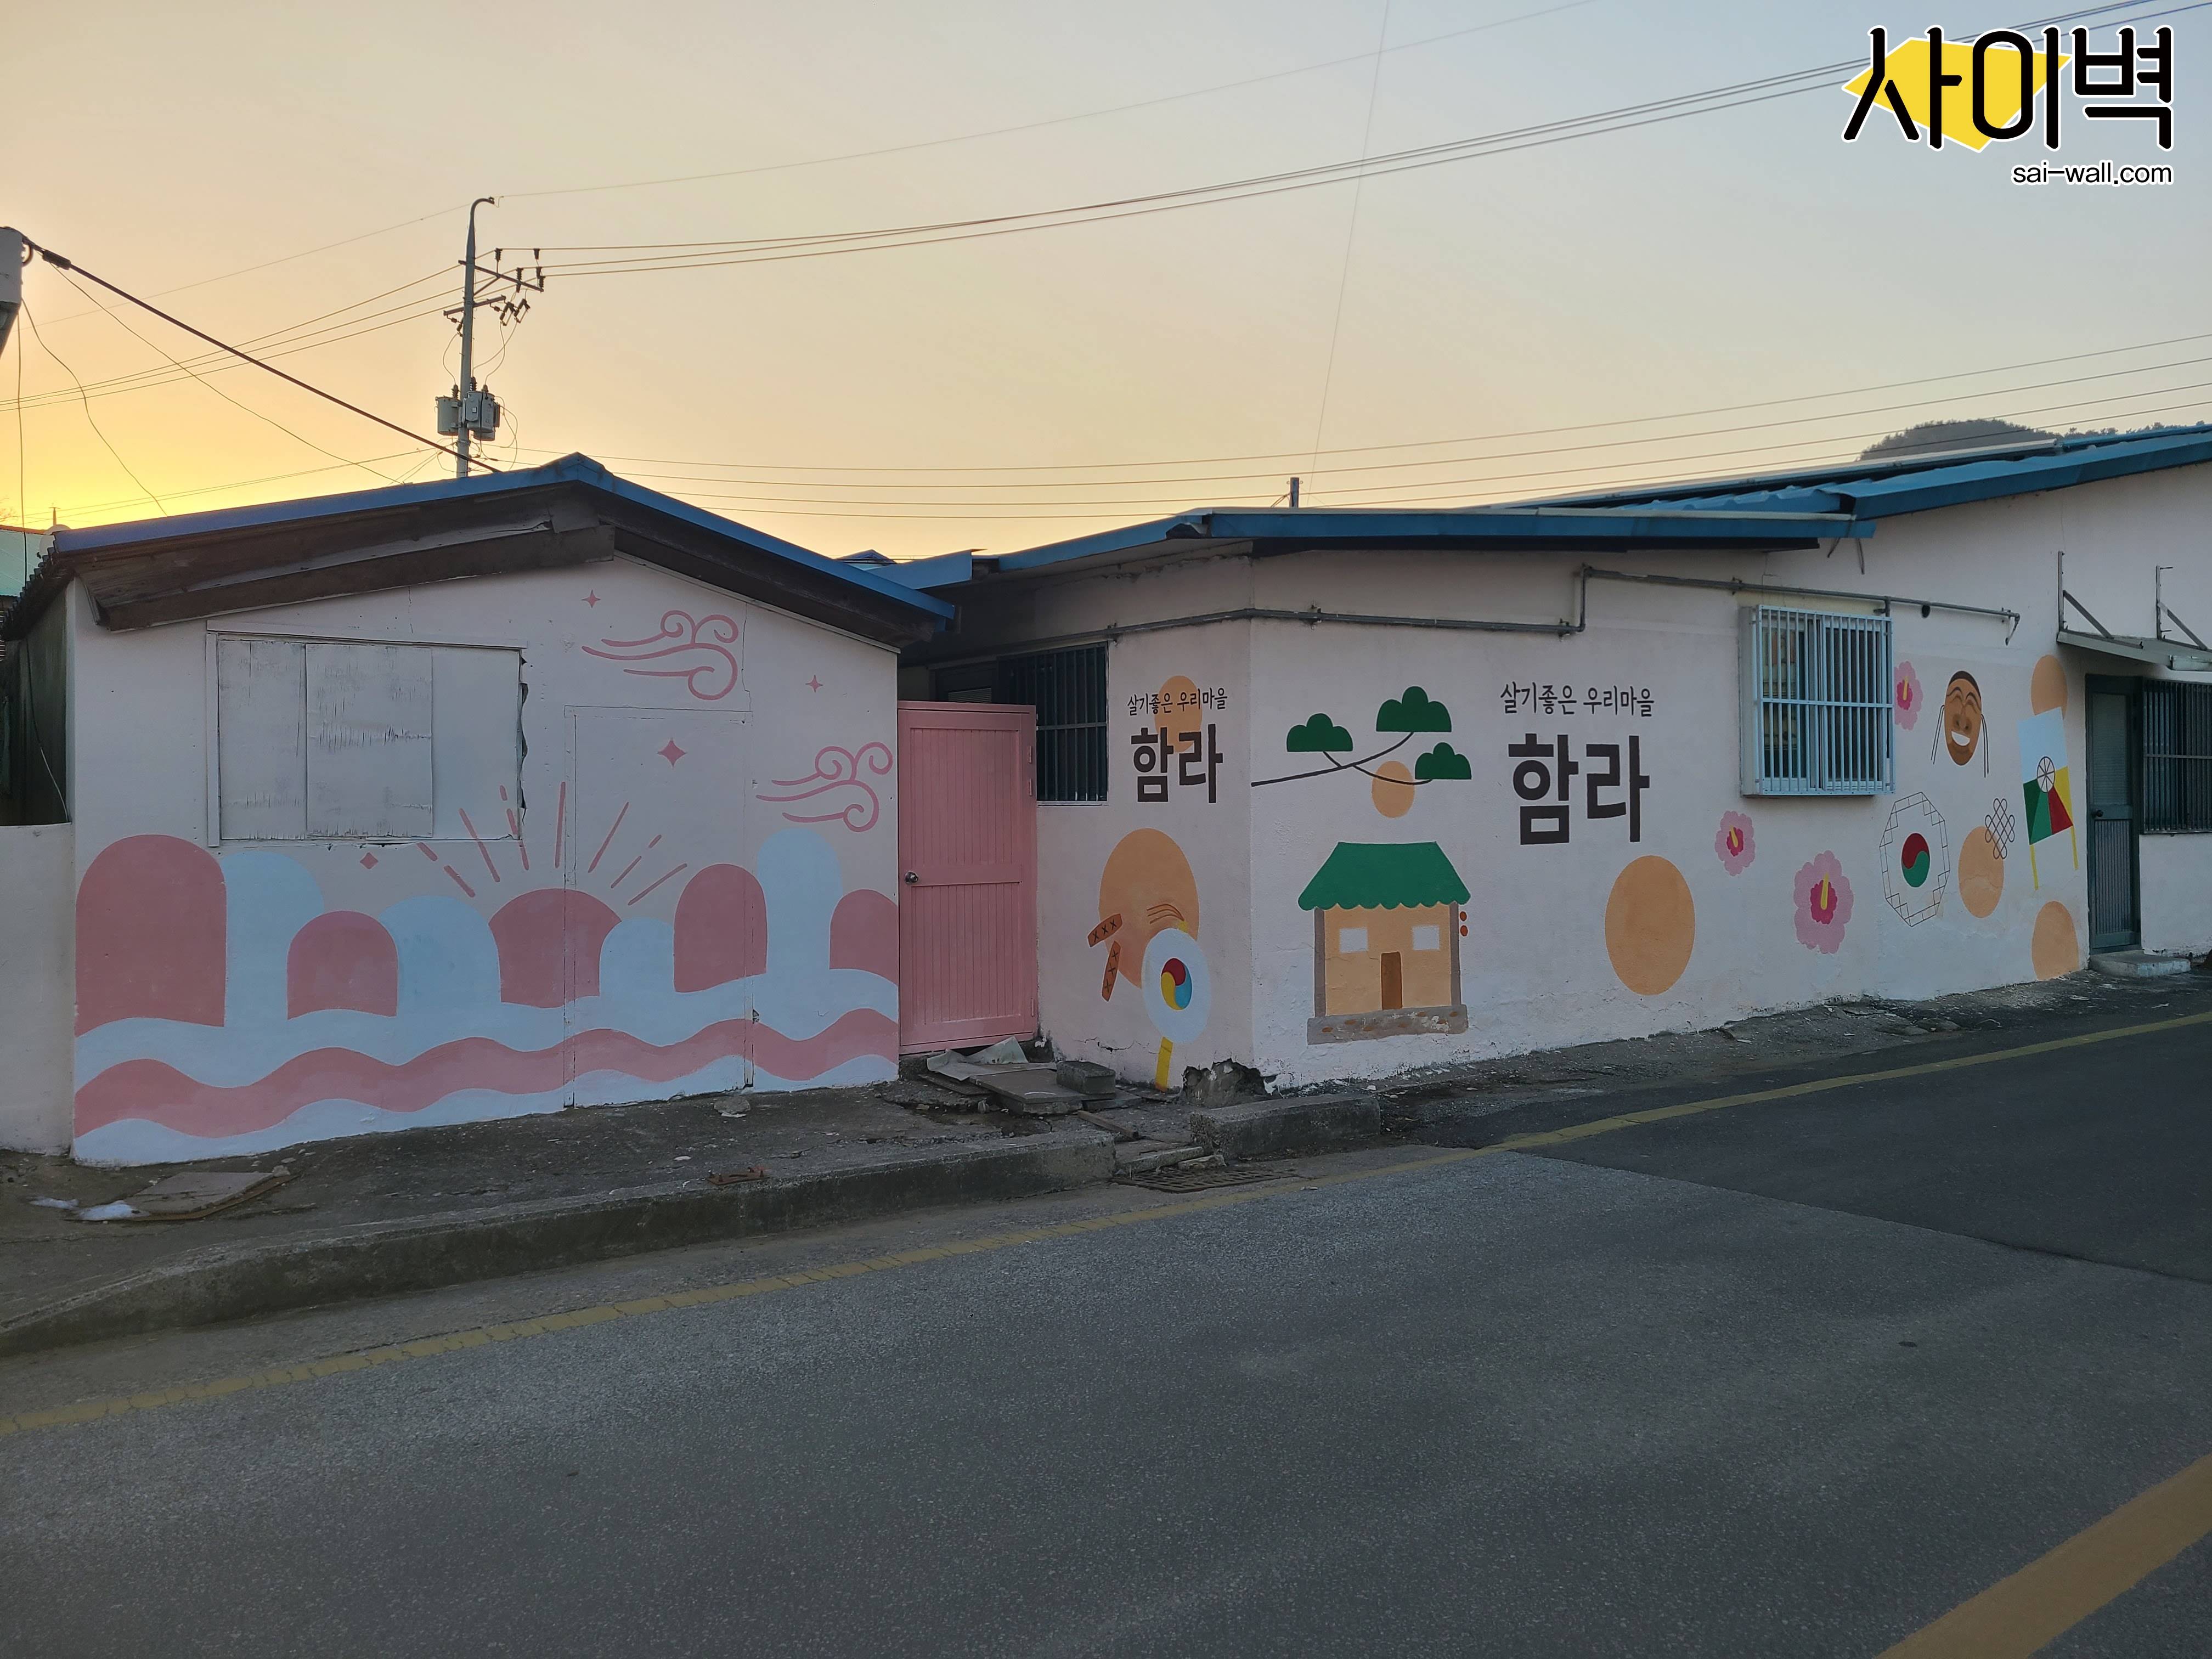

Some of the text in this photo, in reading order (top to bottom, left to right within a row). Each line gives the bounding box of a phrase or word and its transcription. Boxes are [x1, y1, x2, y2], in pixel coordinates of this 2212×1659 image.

[1127, 687, 1228, 716] 살기좋은 우리마을
[1500, 681, 1655, 717] 살기좋은 우리마을
[1131, 723, 1223, 803] 함라
[1508, 733, 1650, 845] 함라
